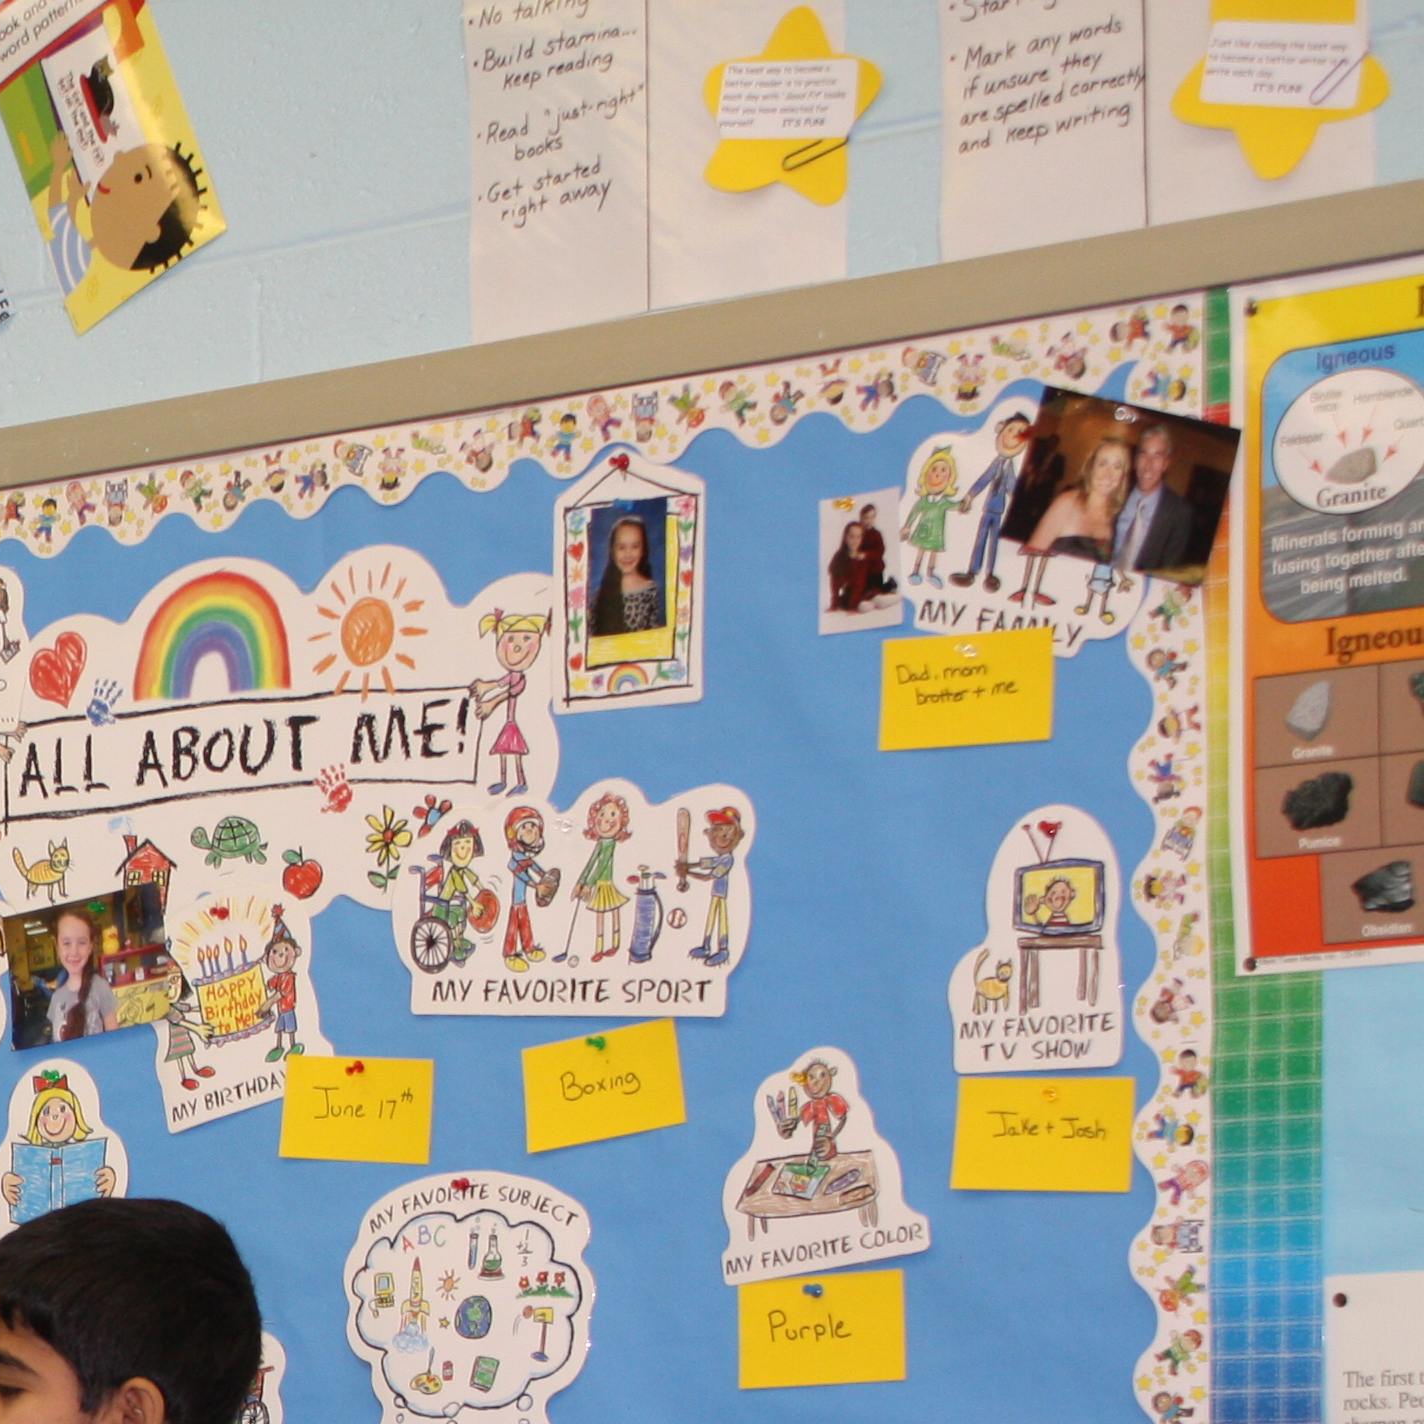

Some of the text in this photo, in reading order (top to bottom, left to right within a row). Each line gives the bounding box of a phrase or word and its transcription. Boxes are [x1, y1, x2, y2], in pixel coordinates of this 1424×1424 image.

[479, 8, 502, 28] No
[0, 28, 30, 62] word
[483, 38, 534, 72] Build
[965, 15, 1122, 70] Mark any words
[548, 53, 613, 73] reading
[963, 52, 1103, 100] if unsure they
[960, 66, 1145, 126] are spelled correctly
[487, 113, 529, 144] Read
[959, 103, 1131, 154] and writing
[515, 137, 563, 161] books
[487, 155, 601, 203] Get started
[502, 180, 612, 228] right away
[1317, 483, 1386, 508] Granite
[1272, 523, 1403, 553] Minerals forming
[1273, 548, 1391, 575] fusing together
[1301, 578, 1344, 595] being
[919, 600, 966, 627] MY
[991, 681, 1017, 694] me
[20, 697, 469, 797] ALL ABOUT ME!
[432, 978, 712, 1003] MY FAVORITE SPORT
[959, 1012, 1115, 1039] MY FAVORITE
[980, 1040, 1092, 1062] TV SHOW
[560, 1071, 641, 1101] Boxing
[172, 1099, 197, 1123] MY
[313, 1085, 366, 1119] June
[987, 1111, 1106, 1139] Jake Josh
[369, 1185, 579, 1234] MY SUBJECT
[725, 1223, 924, 1276] MY FAVORITE COLOR
[768, 1310, 851, 1343] Purple
[1343, 1370, 1414, 1388] The first
[1343, 1395, 1391, 1411] rocks.
